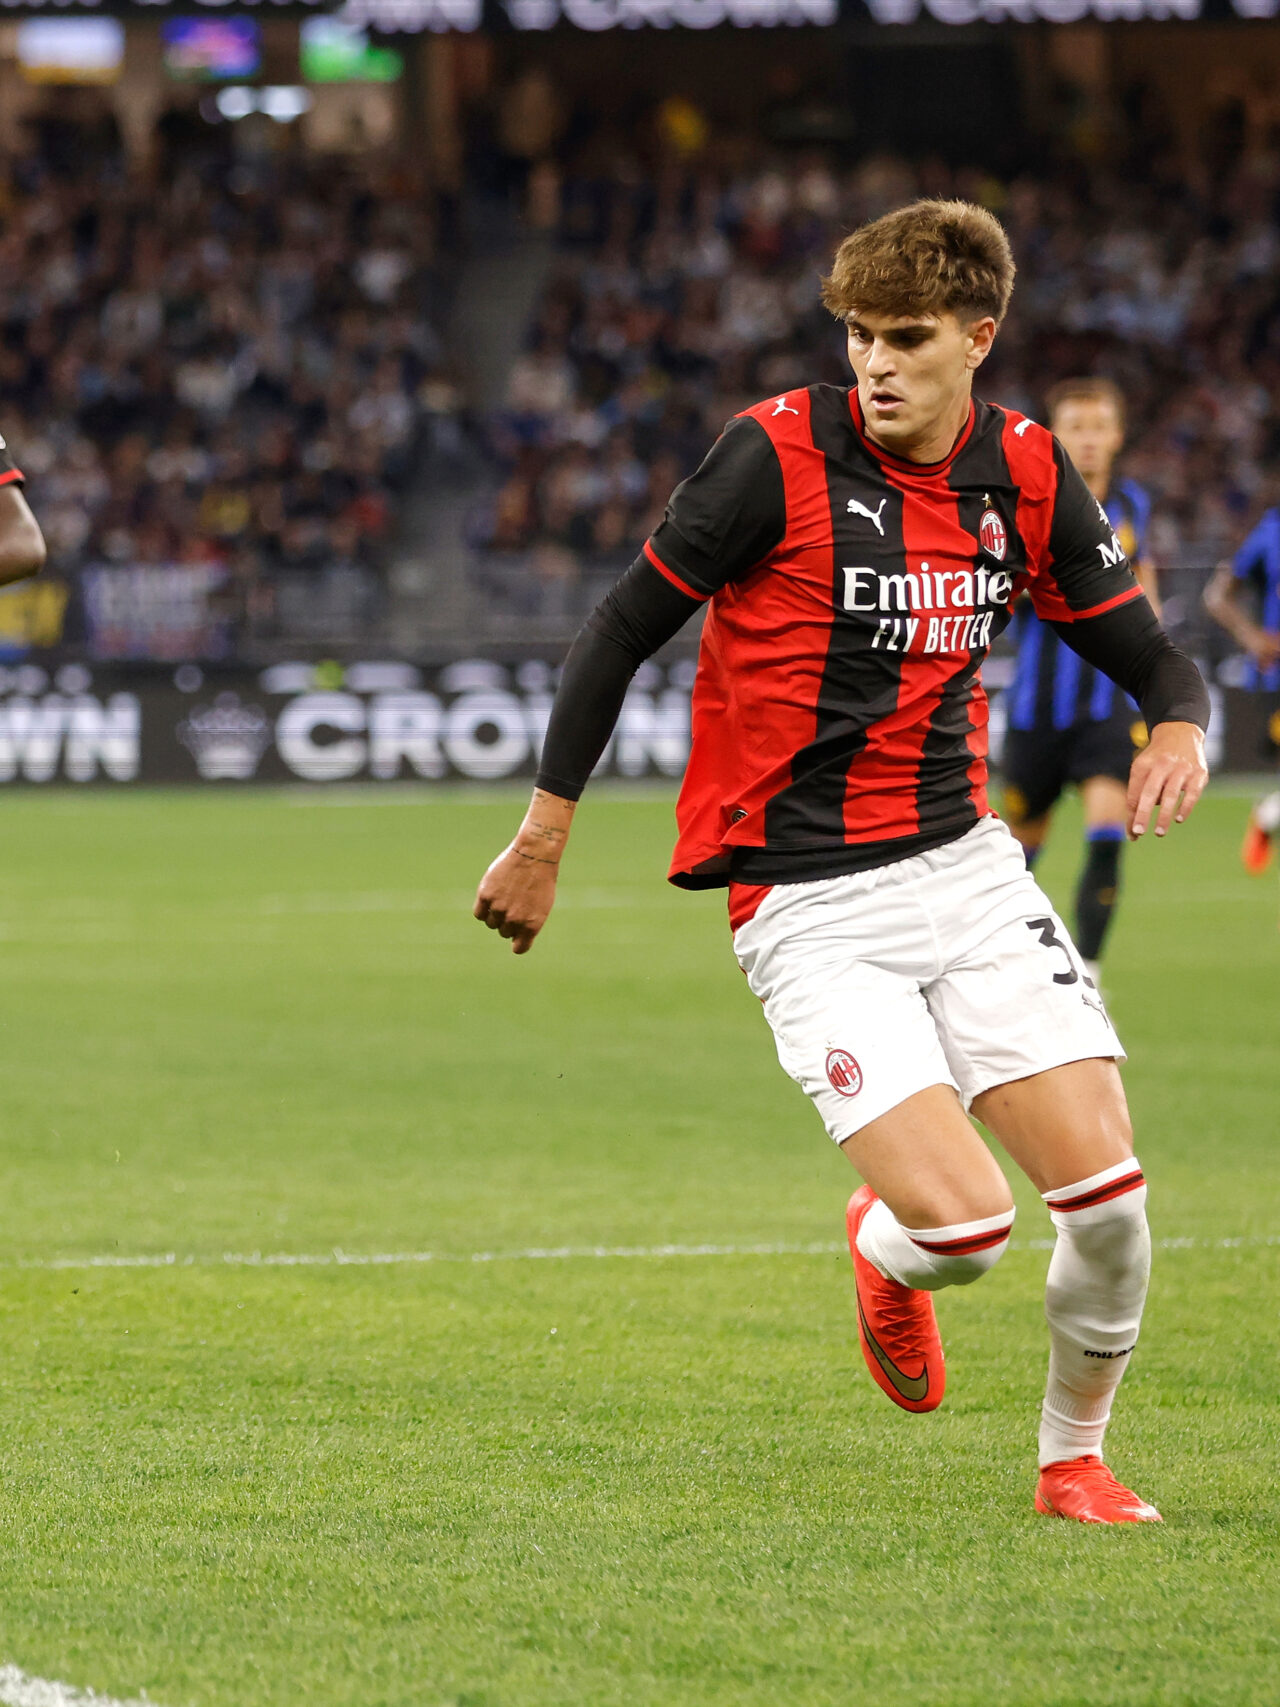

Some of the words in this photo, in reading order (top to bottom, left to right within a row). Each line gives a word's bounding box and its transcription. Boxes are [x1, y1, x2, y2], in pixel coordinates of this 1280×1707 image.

[842, 562, 1013, 611] Emirate
[871, 618, 919, 653] FLY
[923, 611, 994, 654] BETTER
